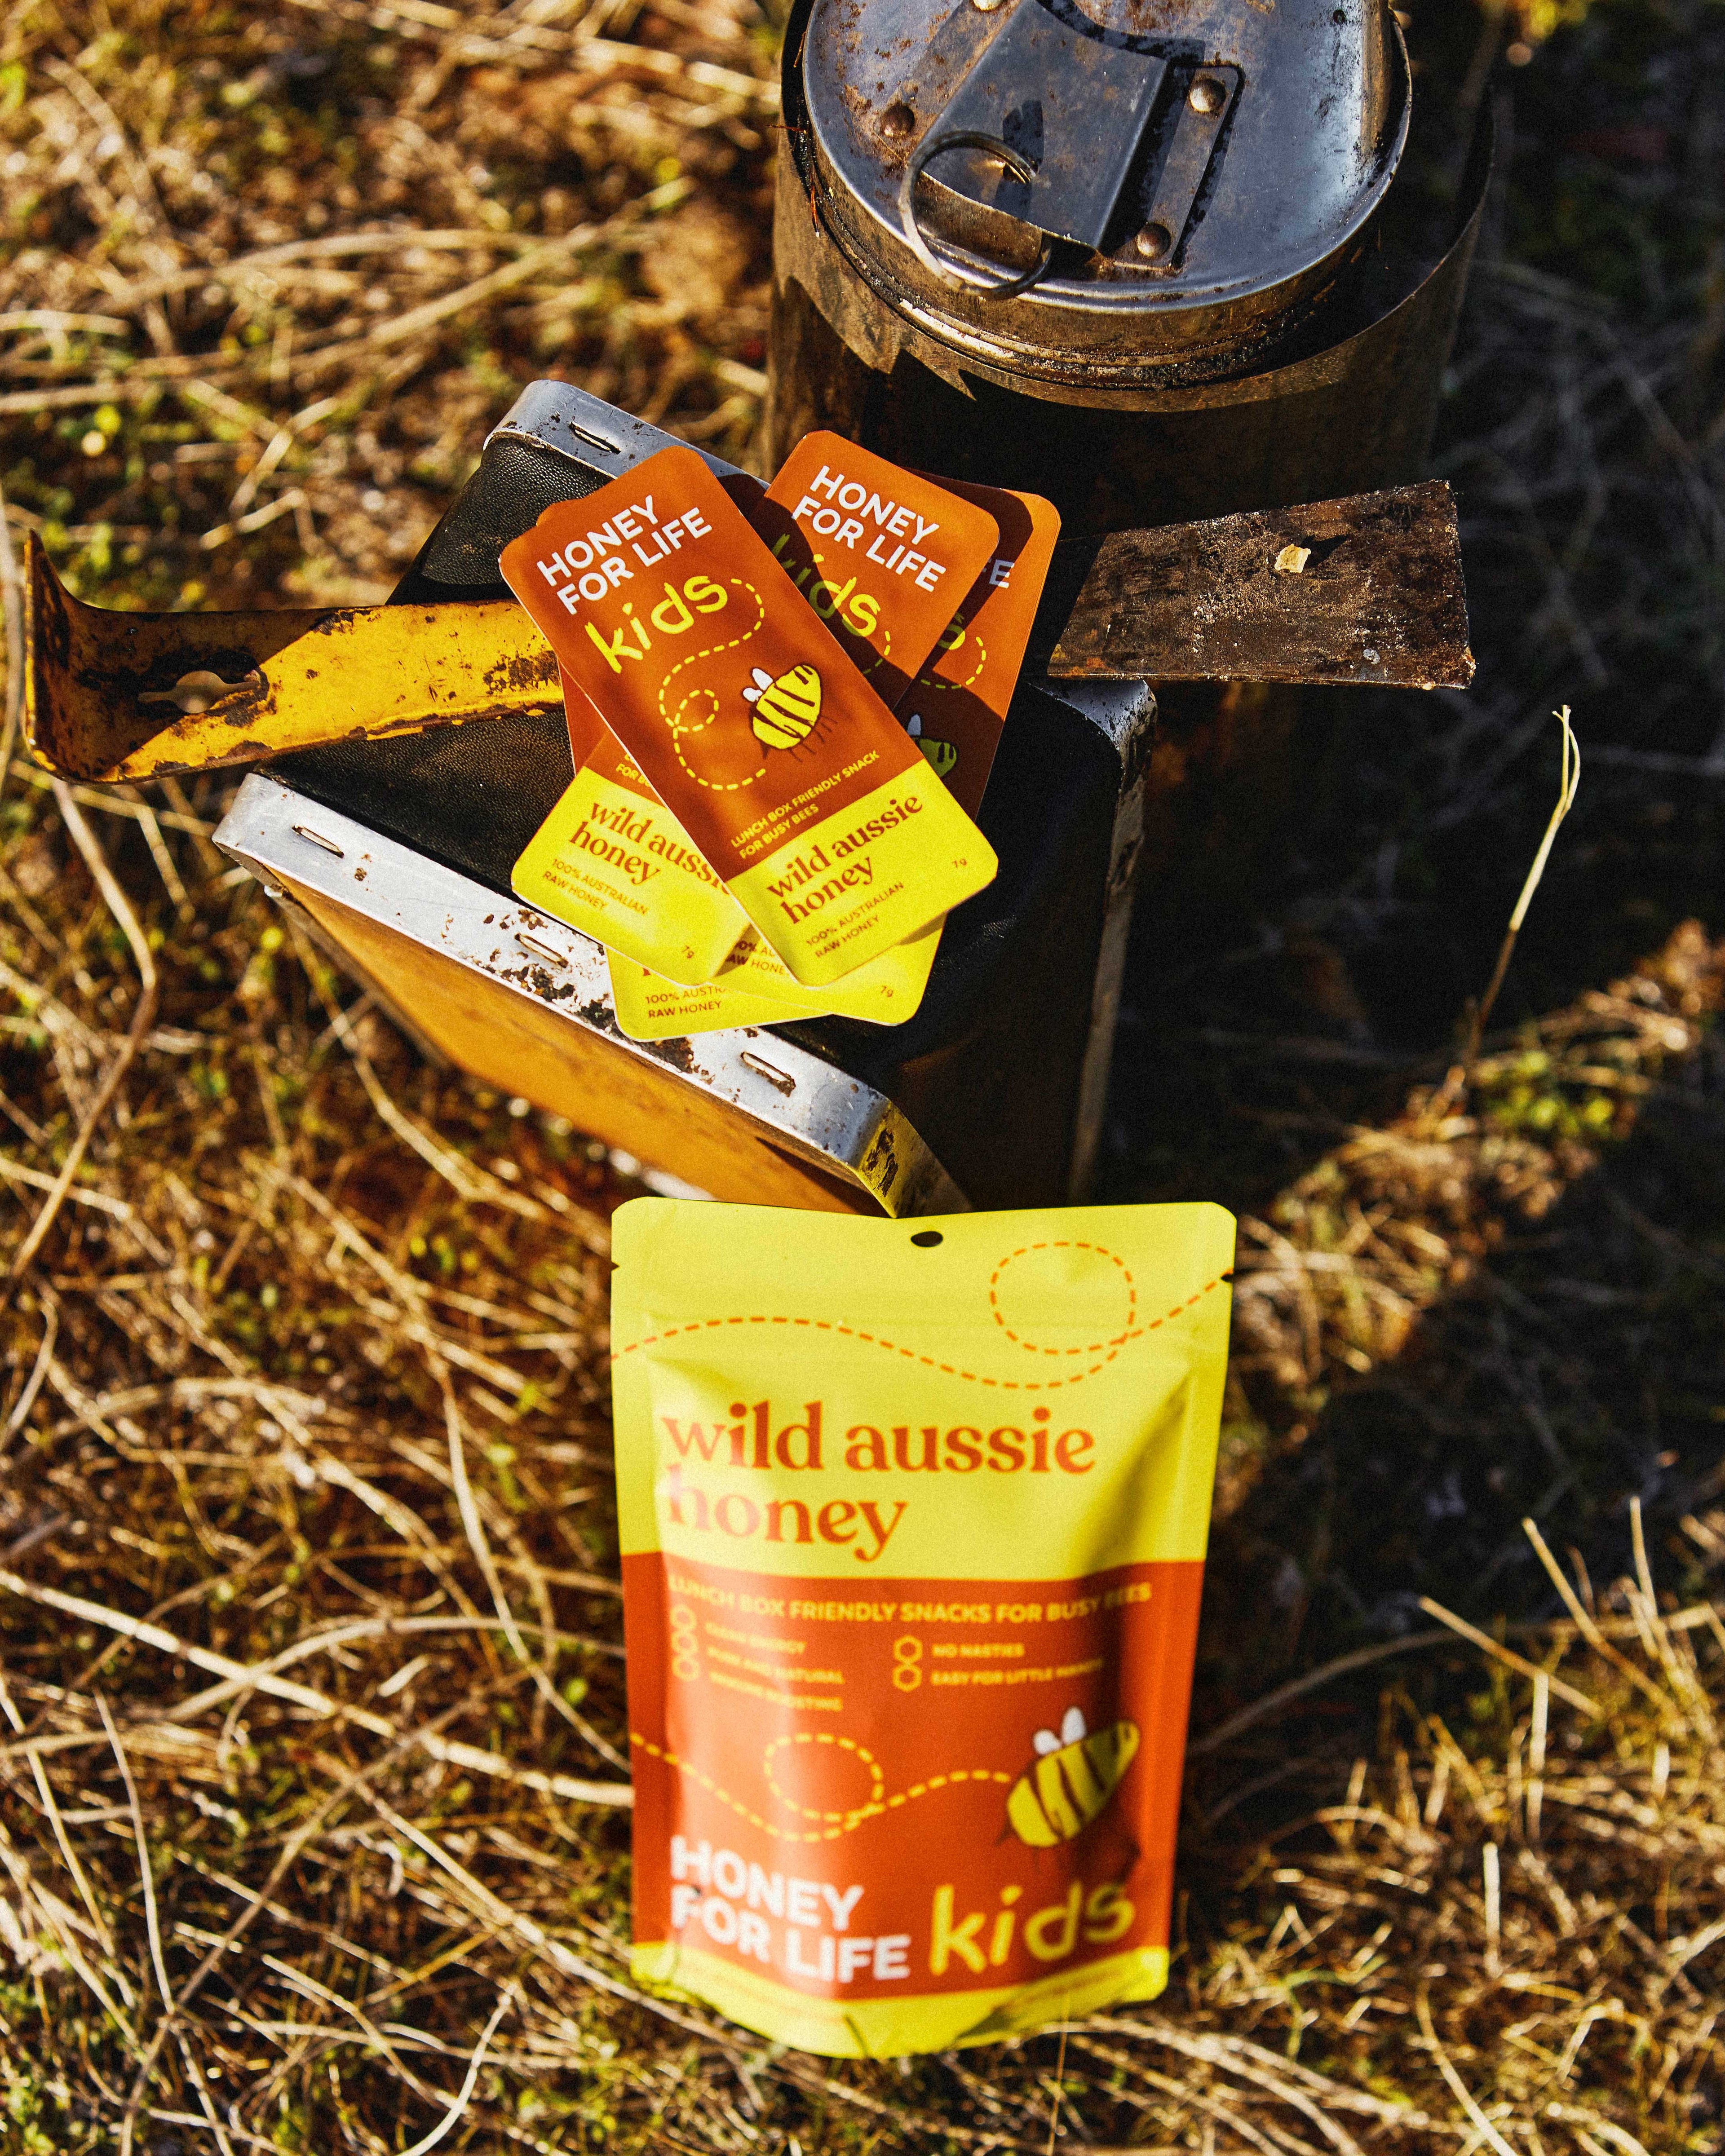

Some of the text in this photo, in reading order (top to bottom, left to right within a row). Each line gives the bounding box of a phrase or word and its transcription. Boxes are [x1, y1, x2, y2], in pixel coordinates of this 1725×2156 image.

[810, 465, 939, 545] HONEY
[537, 495, 658, 586] HONEY
[557, 507, 712, 615] FOR LIFE
[792, 495, 863, 549] FOR
[866, 535, 946, 592] LIFE
[584, 576, 727, 674] kids
[616, 763, 639, 780] FOR
[731, 750, 880, 848] LUNCH BOX FRIENDLY SNACK
[569, 822, 661, 884] honey
[590, 802, 730, 895] wild auss
[739, 804, 818, 859] FOR BUSY BEES
[767, 796, 923, 899] wild aussie
[951, 858, 967, 868] 7g
[543, 871, 608, 910] RAW HONEY
[553, 858, 650, 916] 100% AUSTRALIAN
[780, 856, 873, 925] honey
[806, 882, 904, 945] 100% AUSTRALIAN
[681, 945, 694, 959] 7g
[725, 954, 784, 974] AW HONE
[815, 915, 880, 958] RAW HONEY
[645, 994, 679, 1004] 100%
[648, 1001, 721, 1018] RAW HONEY
[880, 985, 894, 998] 7g
[660, 1401, 1096, 1475] wild aussie
[665, 1463, 909, 1563] honey
[668, 1573, 735, 1608] LUNCH
[739, 1594, 785, 1617] BOX
[789, 1600, 898, 1622] FRIENDLY
[900, 1601, 991, 1623] SNACKS
[995, 1602, 1043, 1623] FOR
[1046, 1598, 1099, 1621] BUSY
[670, 1835, 865, 1931] HONEY
[671, 1885, 912, 1983] FOR LIFE
[929, 1881, 1136, 1975] kids
